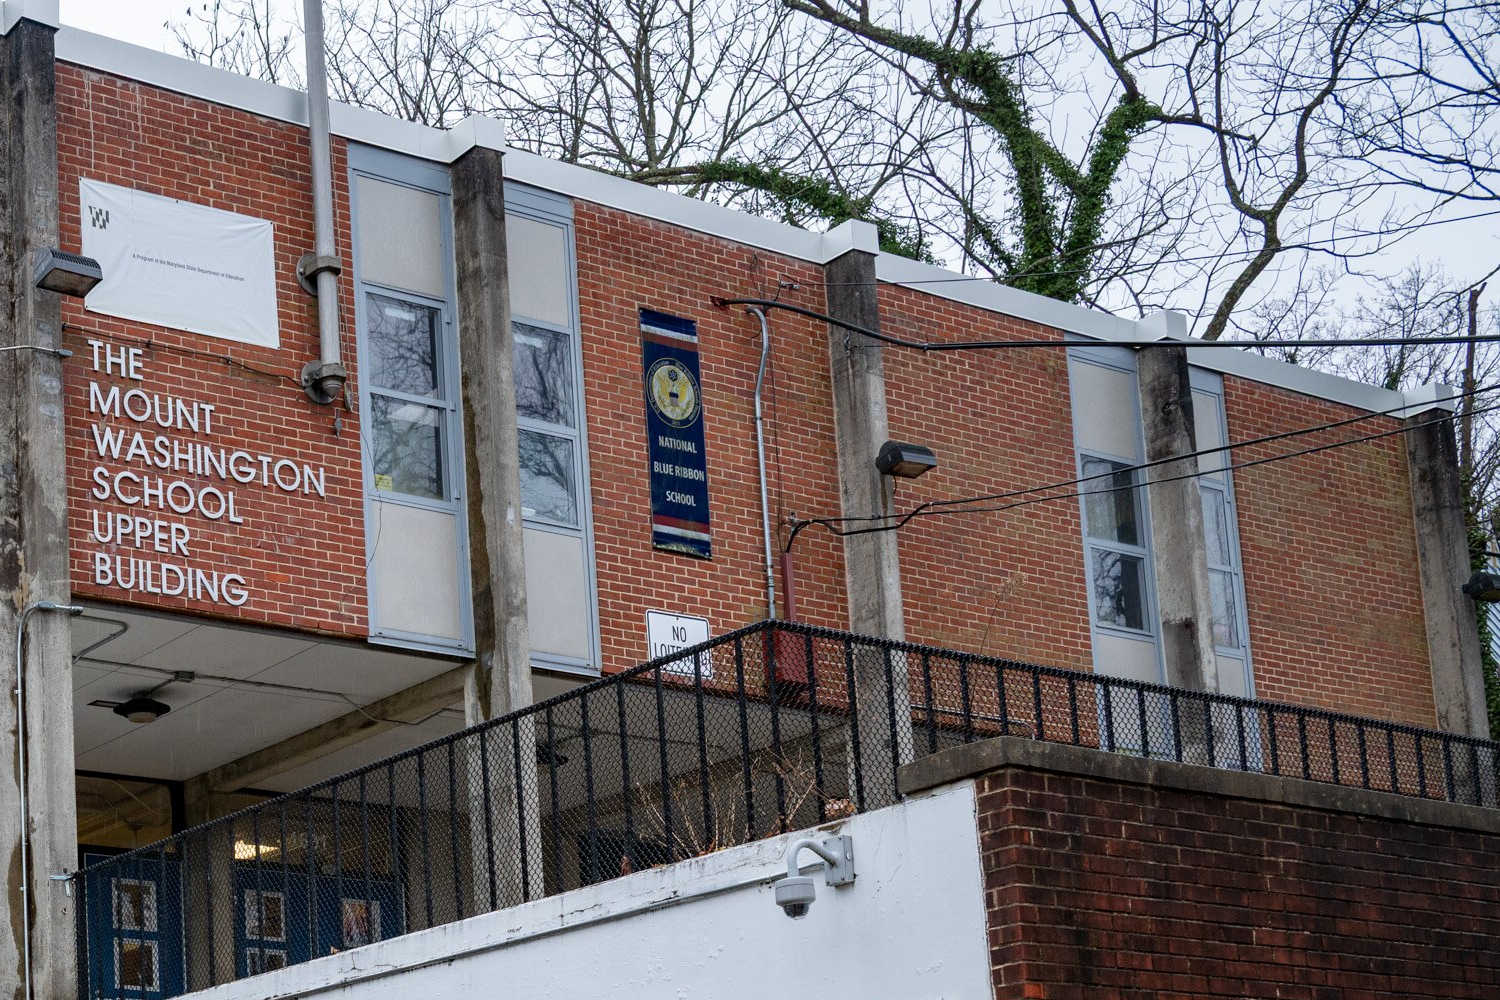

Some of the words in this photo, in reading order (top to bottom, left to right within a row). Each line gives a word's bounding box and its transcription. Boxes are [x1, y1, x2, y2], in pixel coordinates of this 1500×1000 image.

[136, 254, 154, 262] Program
[166, 260, 186, 269] Maryland
[186, 264, 196, 272] State
[197, 267, 220, 276] Department
[225, 274, 244, 282] Education
[87, 339, 144, 380] THE
[89, 381, 215, 435] MOUNT
[92, 424, 325, 498] WASHINGTON
[658, 436, 698, 454] NATIONAL
[654, 461, 674, 475] BLUE
[674, 466, 704, 482] RIBBON
[92, 466, 244, 524] SCHOOL
[666, 490, 696, 506] SCHOOL
[93, 509, 190, 556] UPPER
[95, 552, 248, 606] BUILDING
[672, 626, 687, 642] NO
